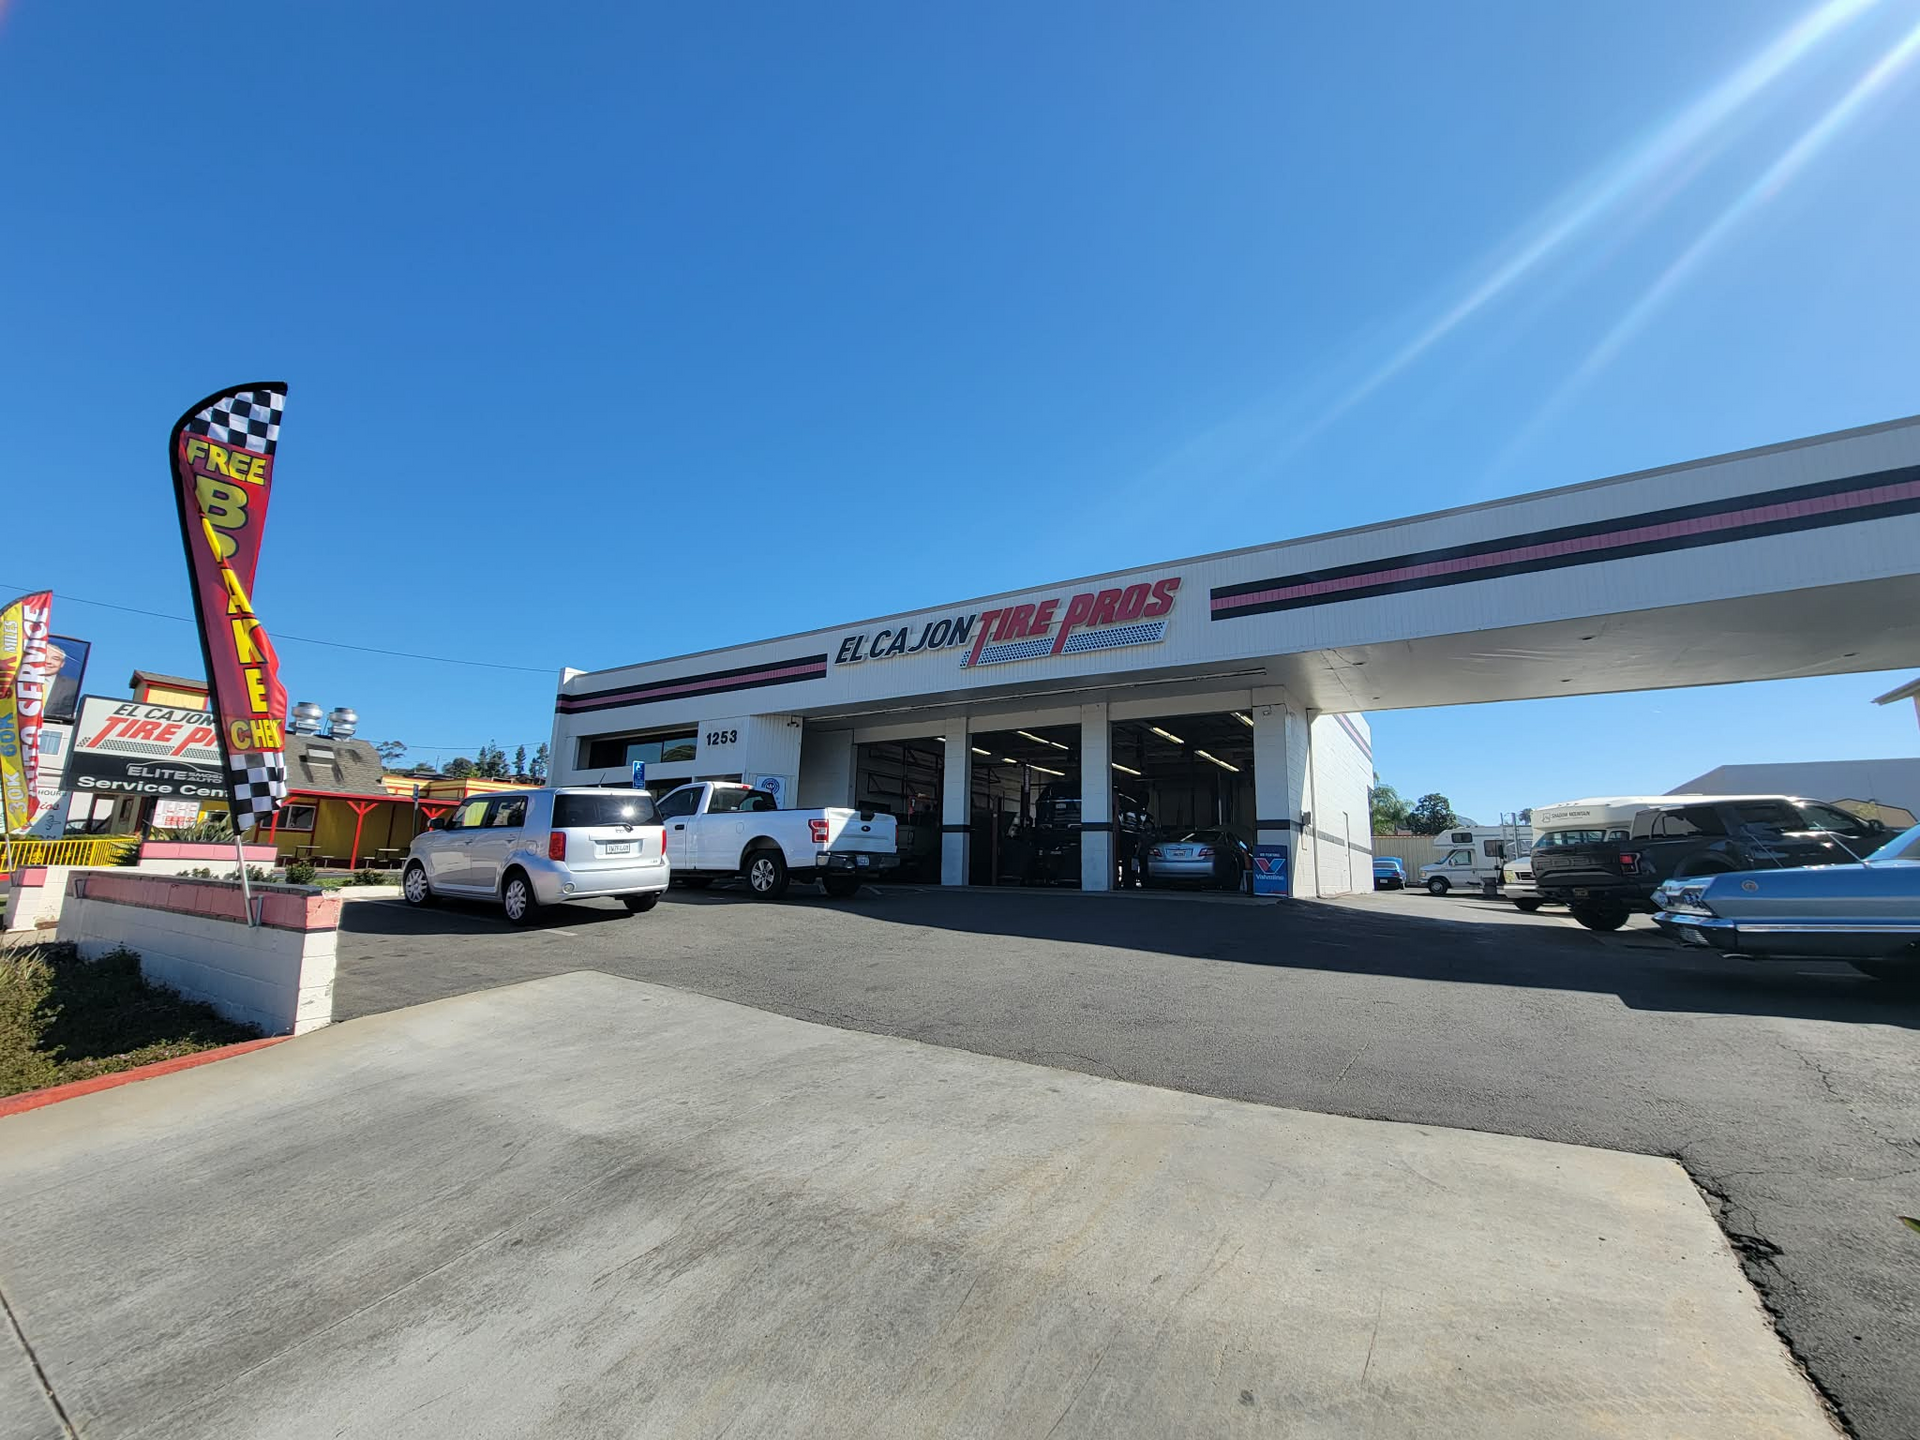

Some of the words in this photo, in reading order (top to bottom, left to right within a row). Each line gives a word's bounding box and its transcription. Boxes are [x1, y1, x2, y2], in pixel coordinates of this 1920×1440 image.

[186, 437, 268, 486] FREE
[834, 635, 865, 664] EL
[869, 614, 978, 660] CAJON
[967, 597, 1060, 667] TIRE
[1050, 577, 1183, 656] PROS
[4, 619, 18, 655] MILES
[17, 604, 49, 717] SERVICE
[113, 703, 138, 717] EL
[86, 715, 183, 748] TIRE
[706, 729, 738, 746] 1253
[77, 776, 174, 794] Service
[179, 784, 228, 798] Cen
[127, 766, 187, 781] ELITE
[187, 776, 223, 785] AUTO
[4, 769, 27, 813] 30K
[1255, 873, 1285, 881] Valvoline
